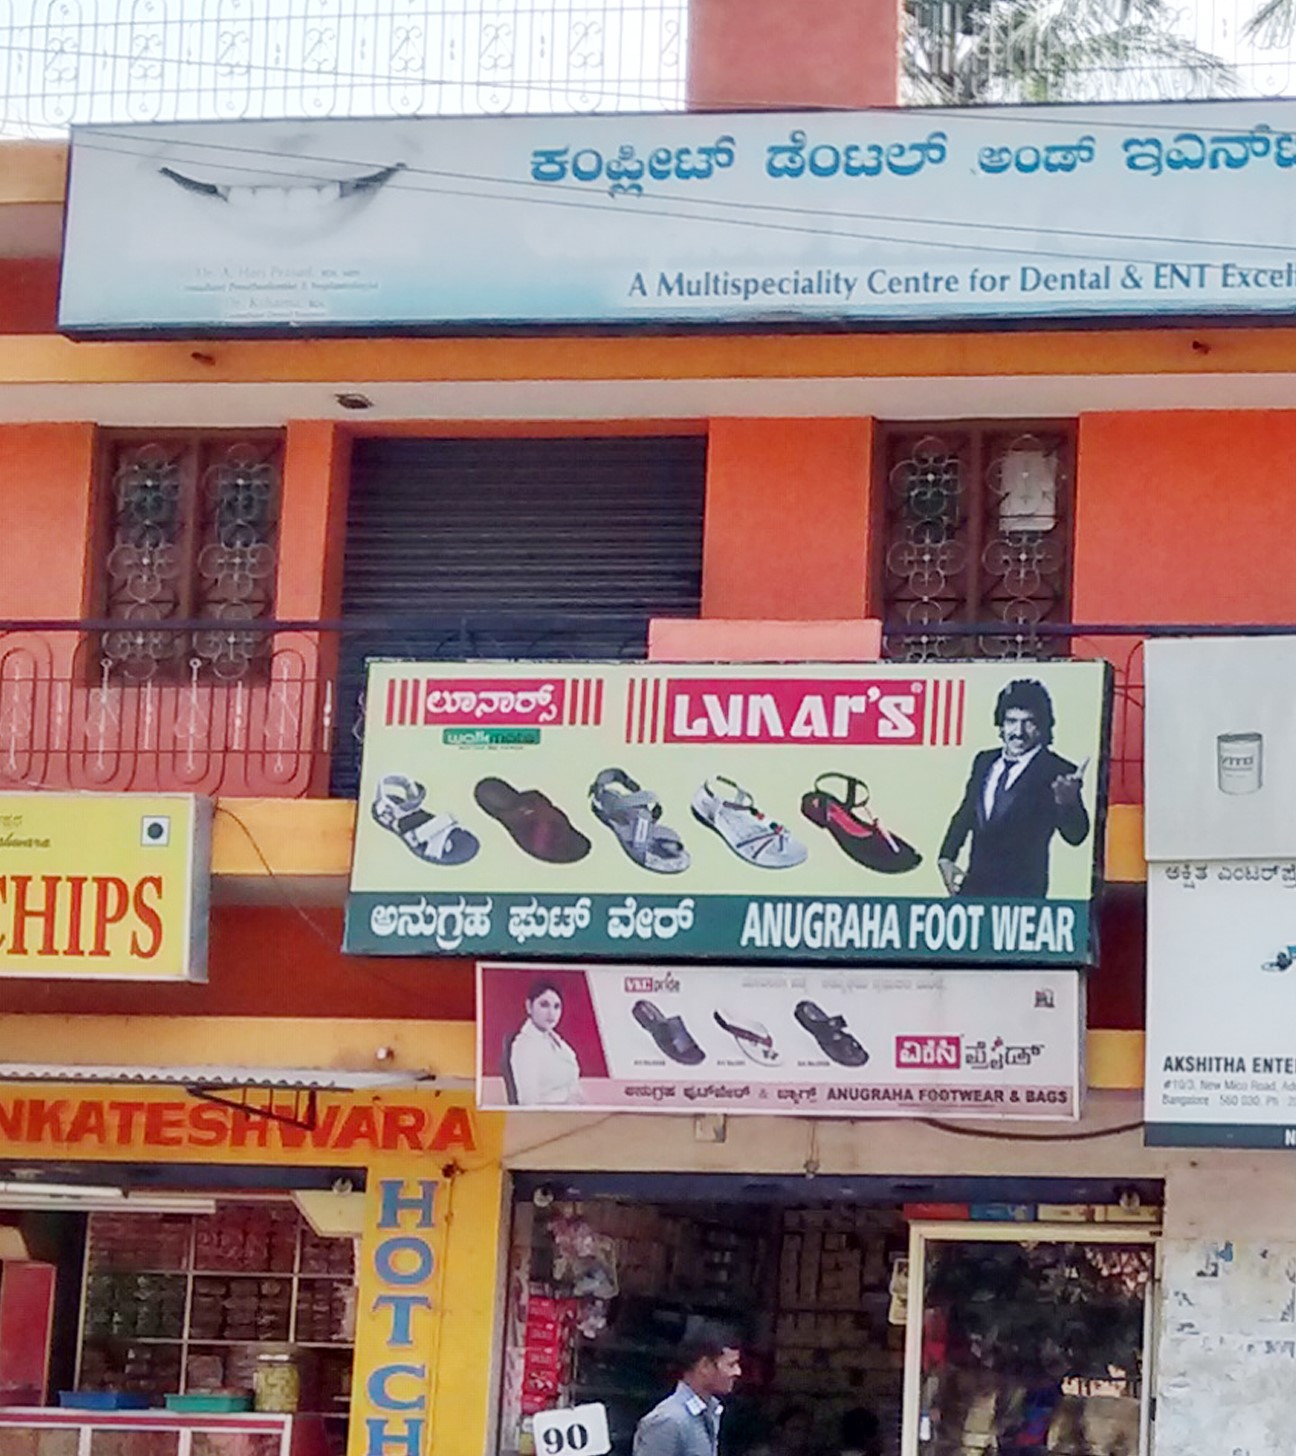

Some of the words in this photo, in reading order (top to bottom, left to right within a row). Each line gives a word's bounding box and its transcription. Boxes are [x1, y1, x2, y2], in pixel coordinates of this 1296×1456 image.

[765, 130, 948, 180] ಡೆಂಟಲ್
[977, 134, 1096, 174] ಅಂಡ್
[628, 274, 648, 297] A
[656, 267, 857, 301] Multispeciality
[866, 269, 960, 296] Centre
[969, 266, 1010, 293] for
[1020, 264, 1111, 293] Dental
[1120, 265, 1144, 291] &
[1153, 263, 1207, 289] ENT
[0, 875, 163, 959] HIPS
[370, 895, 493, 950] ಅನುಗ್ರಹ
[607, 896, 695, 940] ವೇರ್
[741, 903, 899, 950] ANUGRAHA
[909, 905, 992, 950] FOOT
[997, 906, 1074, 953] WEAR
[1163, 1056, 1246, 1074] AKSHITHA
[827, 1088, 914, 1101] ANUGRAHA
[919, 1089, 1004, 1103] FOOTWEAR
[1009, 1090, 1020, 1103] &
[1026, 1090, 1068, 1104] BAGS
[1200, 1080, 1221, 1091] New
[542, 1423, 588, 1455] 90
